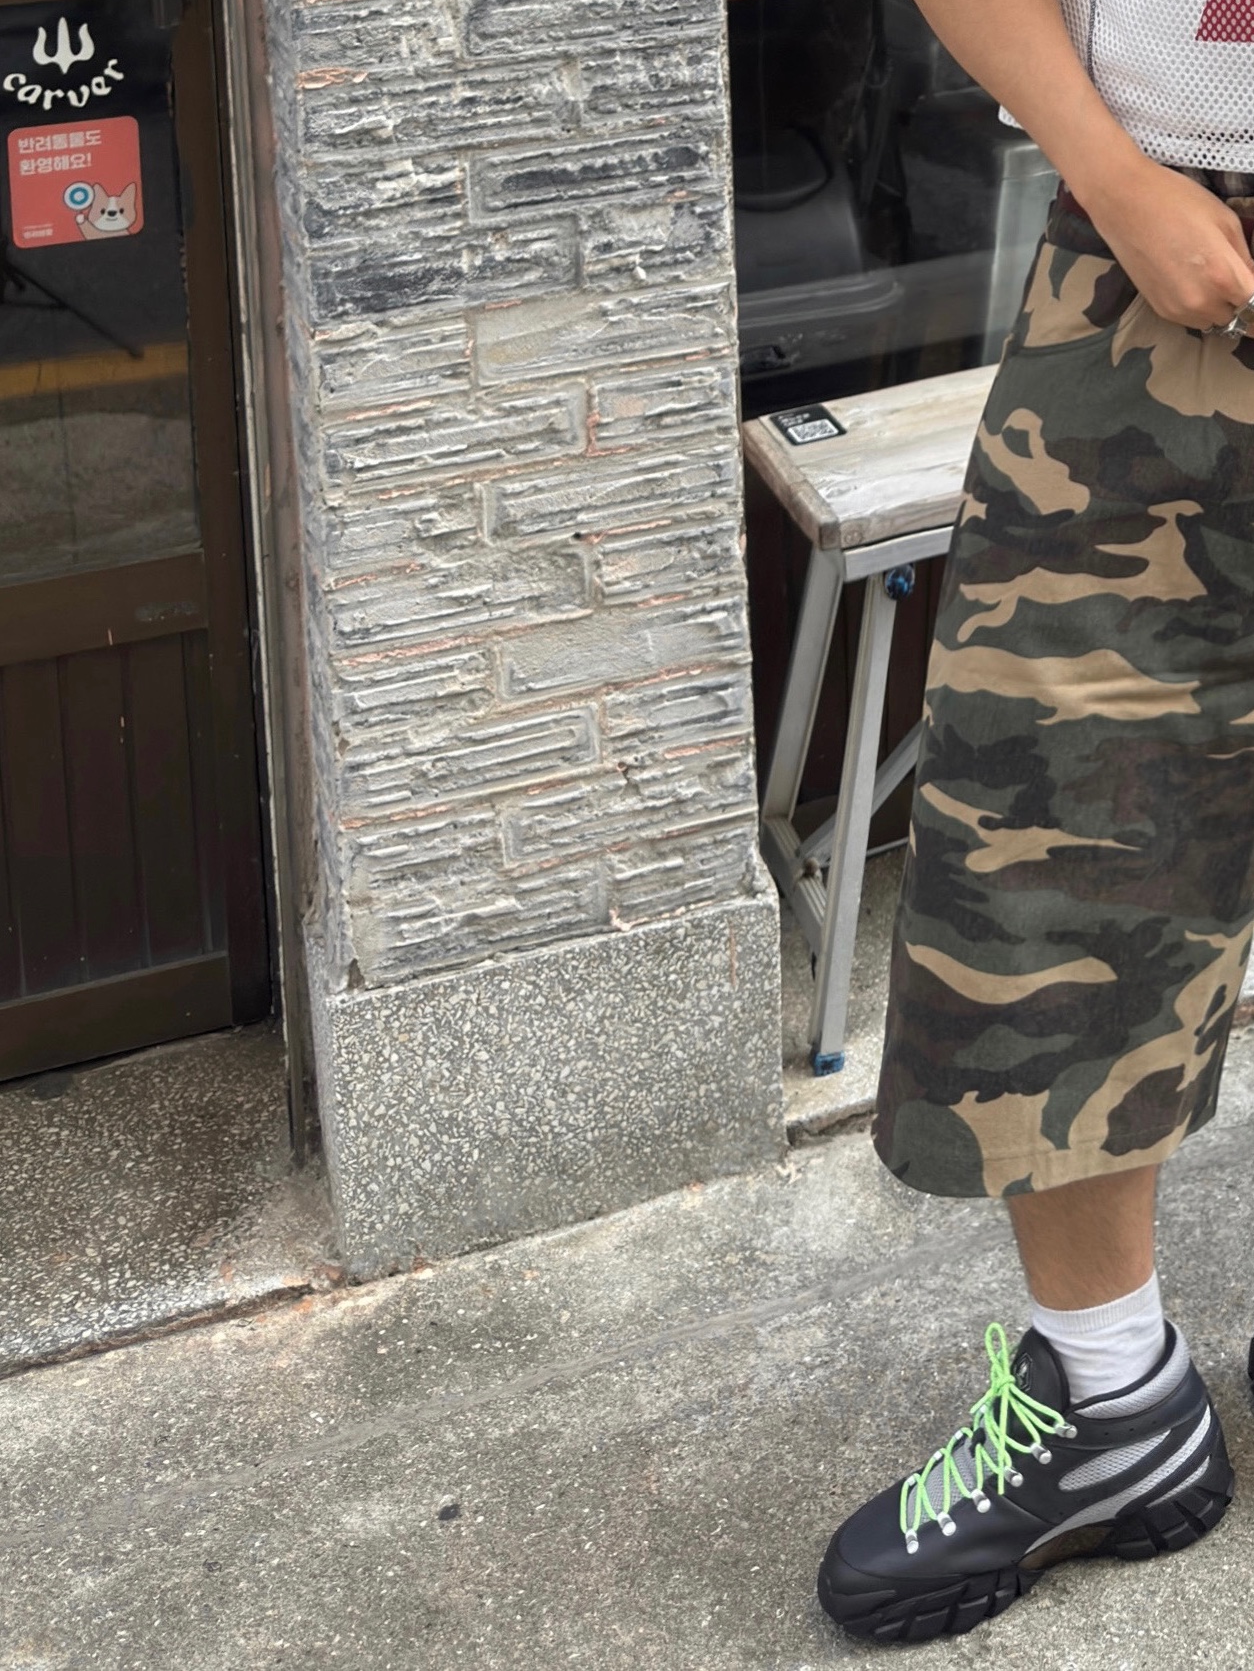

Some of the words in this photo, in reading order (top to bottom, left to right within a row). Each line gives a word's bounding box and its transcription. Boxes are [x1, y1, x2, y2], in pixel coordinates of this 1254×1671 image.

[3, 58, 124, 110] carver
[18, 130, 102, 154] 반려동물도
[20, 152, 92, 176] 환영해요!
